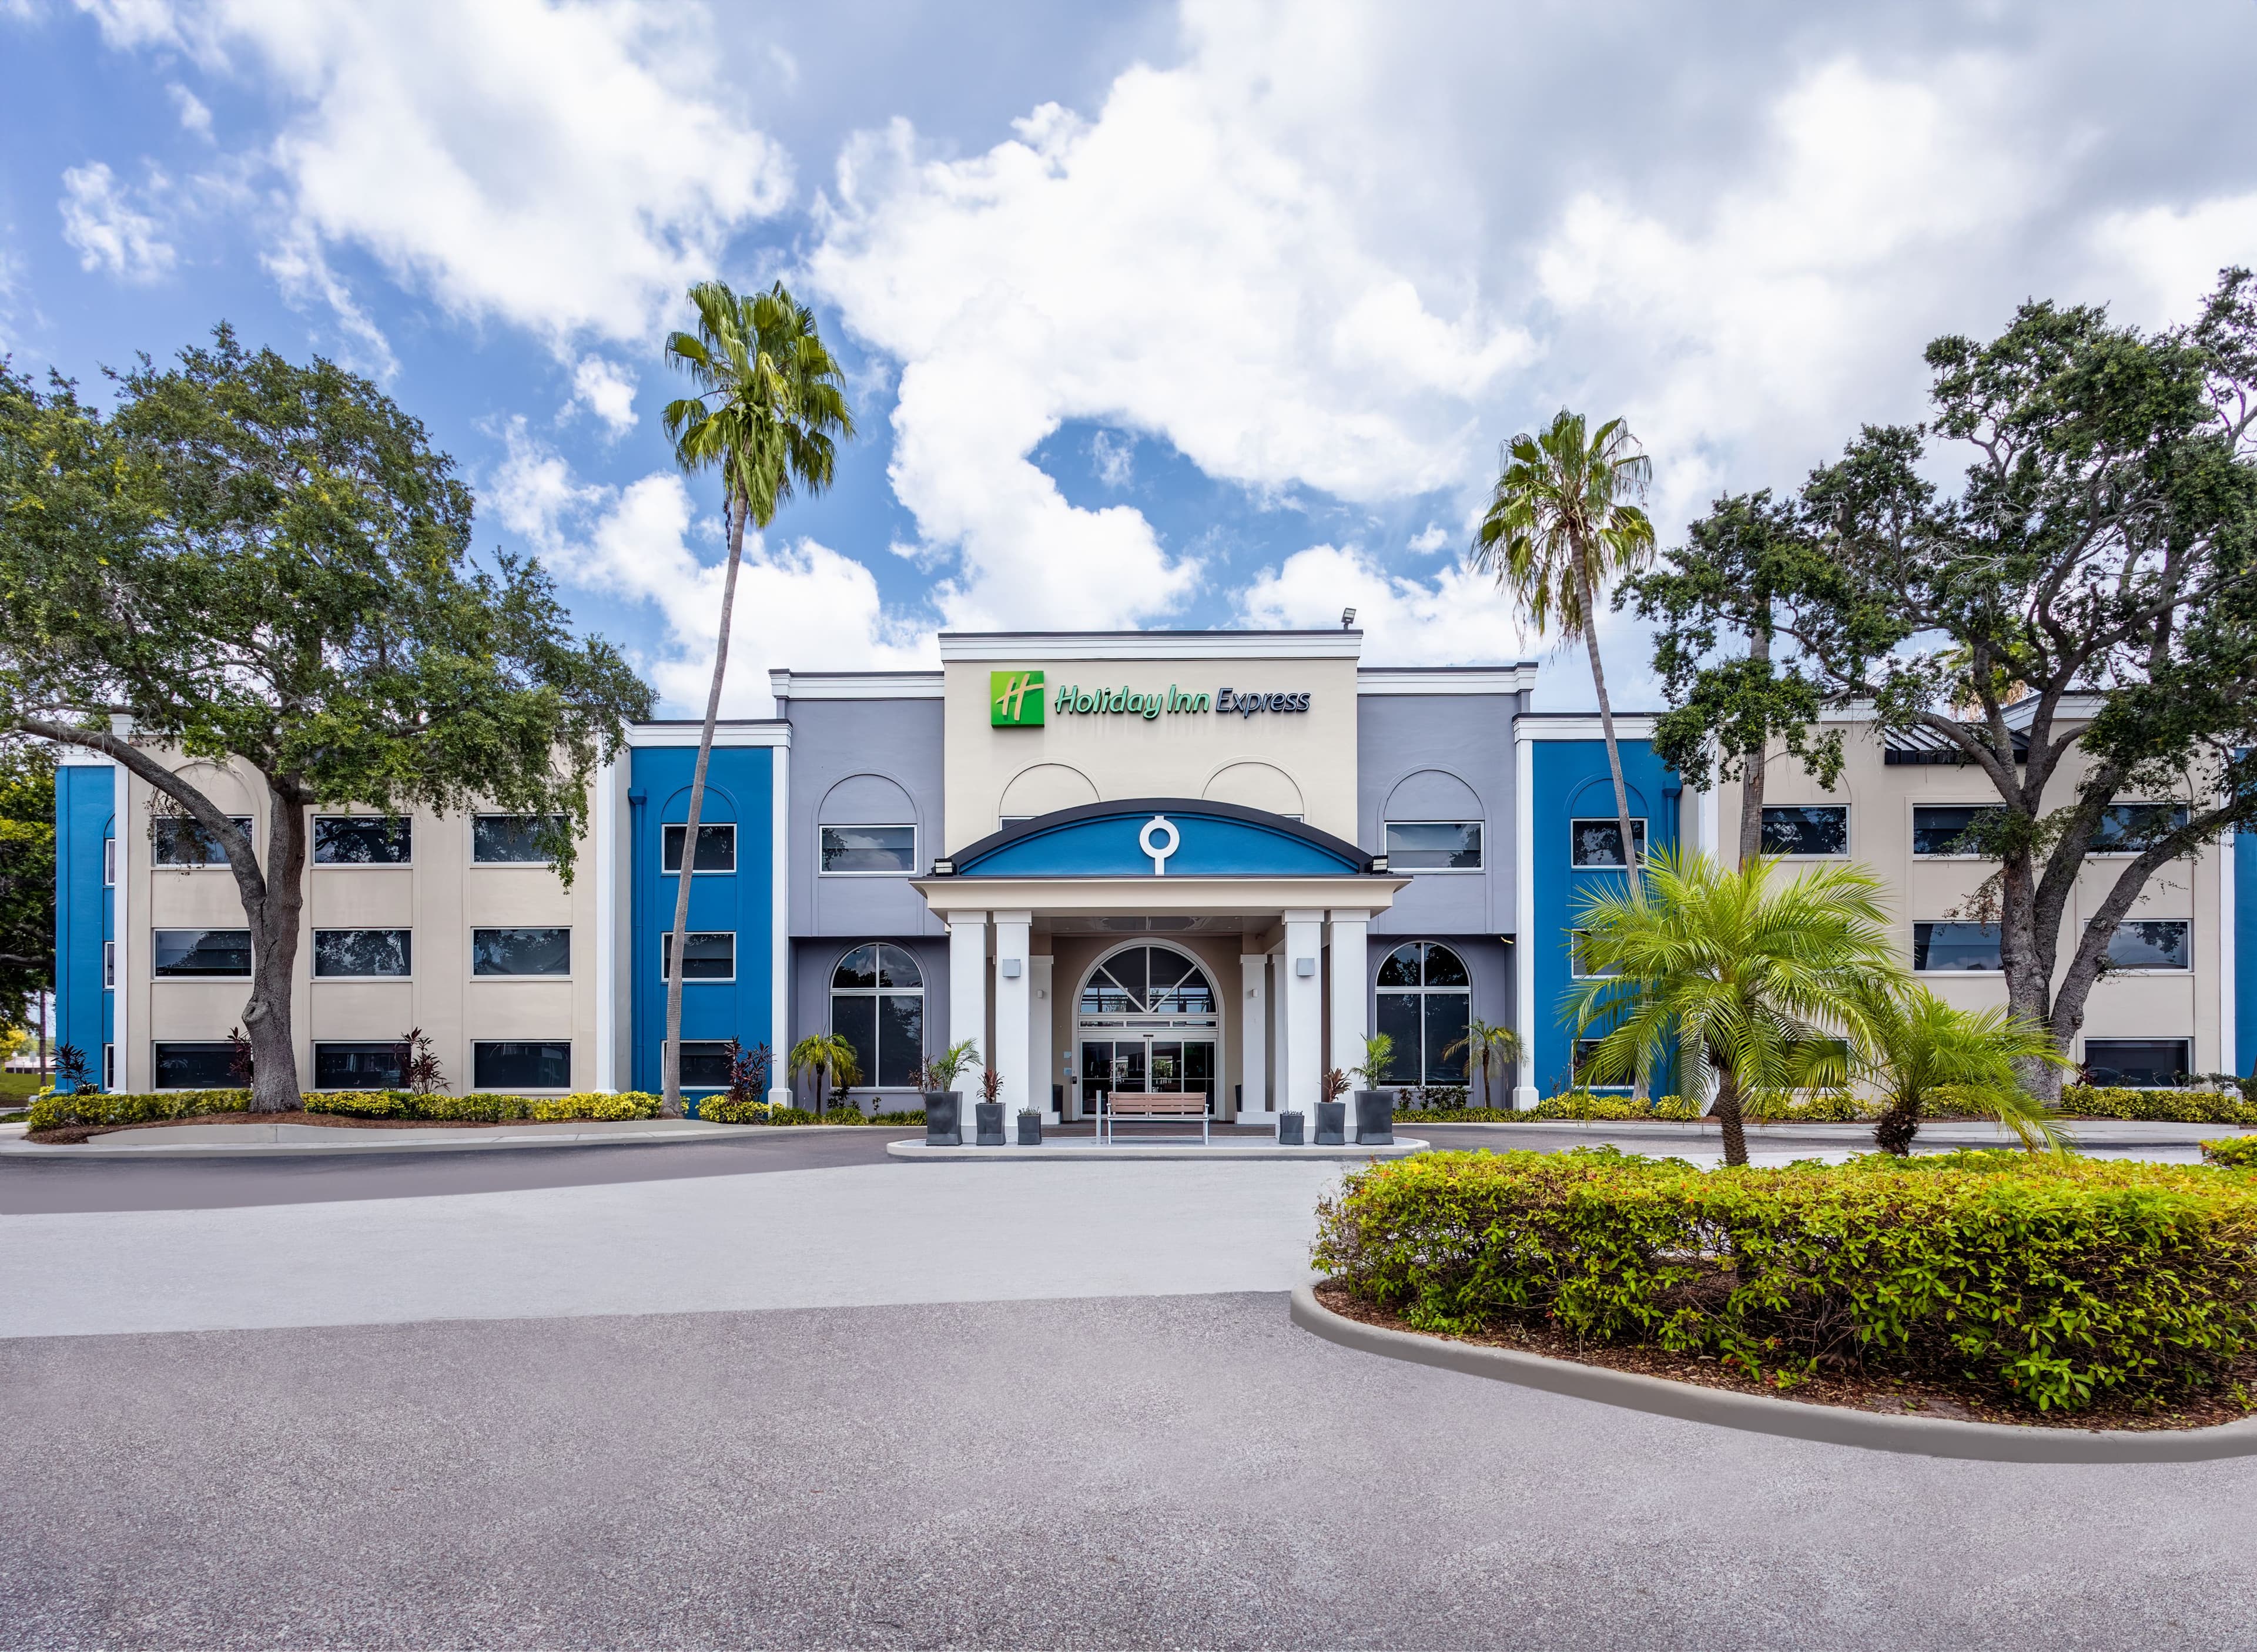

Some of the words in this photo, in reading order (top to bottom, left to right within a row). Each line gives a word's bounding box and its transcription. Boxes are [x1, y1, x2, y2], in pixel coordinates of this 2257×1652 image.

[1054, 685, 1163, 720] Holiday
[1167, 684, 1210, 713] Inn
[1215, 688, 1311, 718] Express
